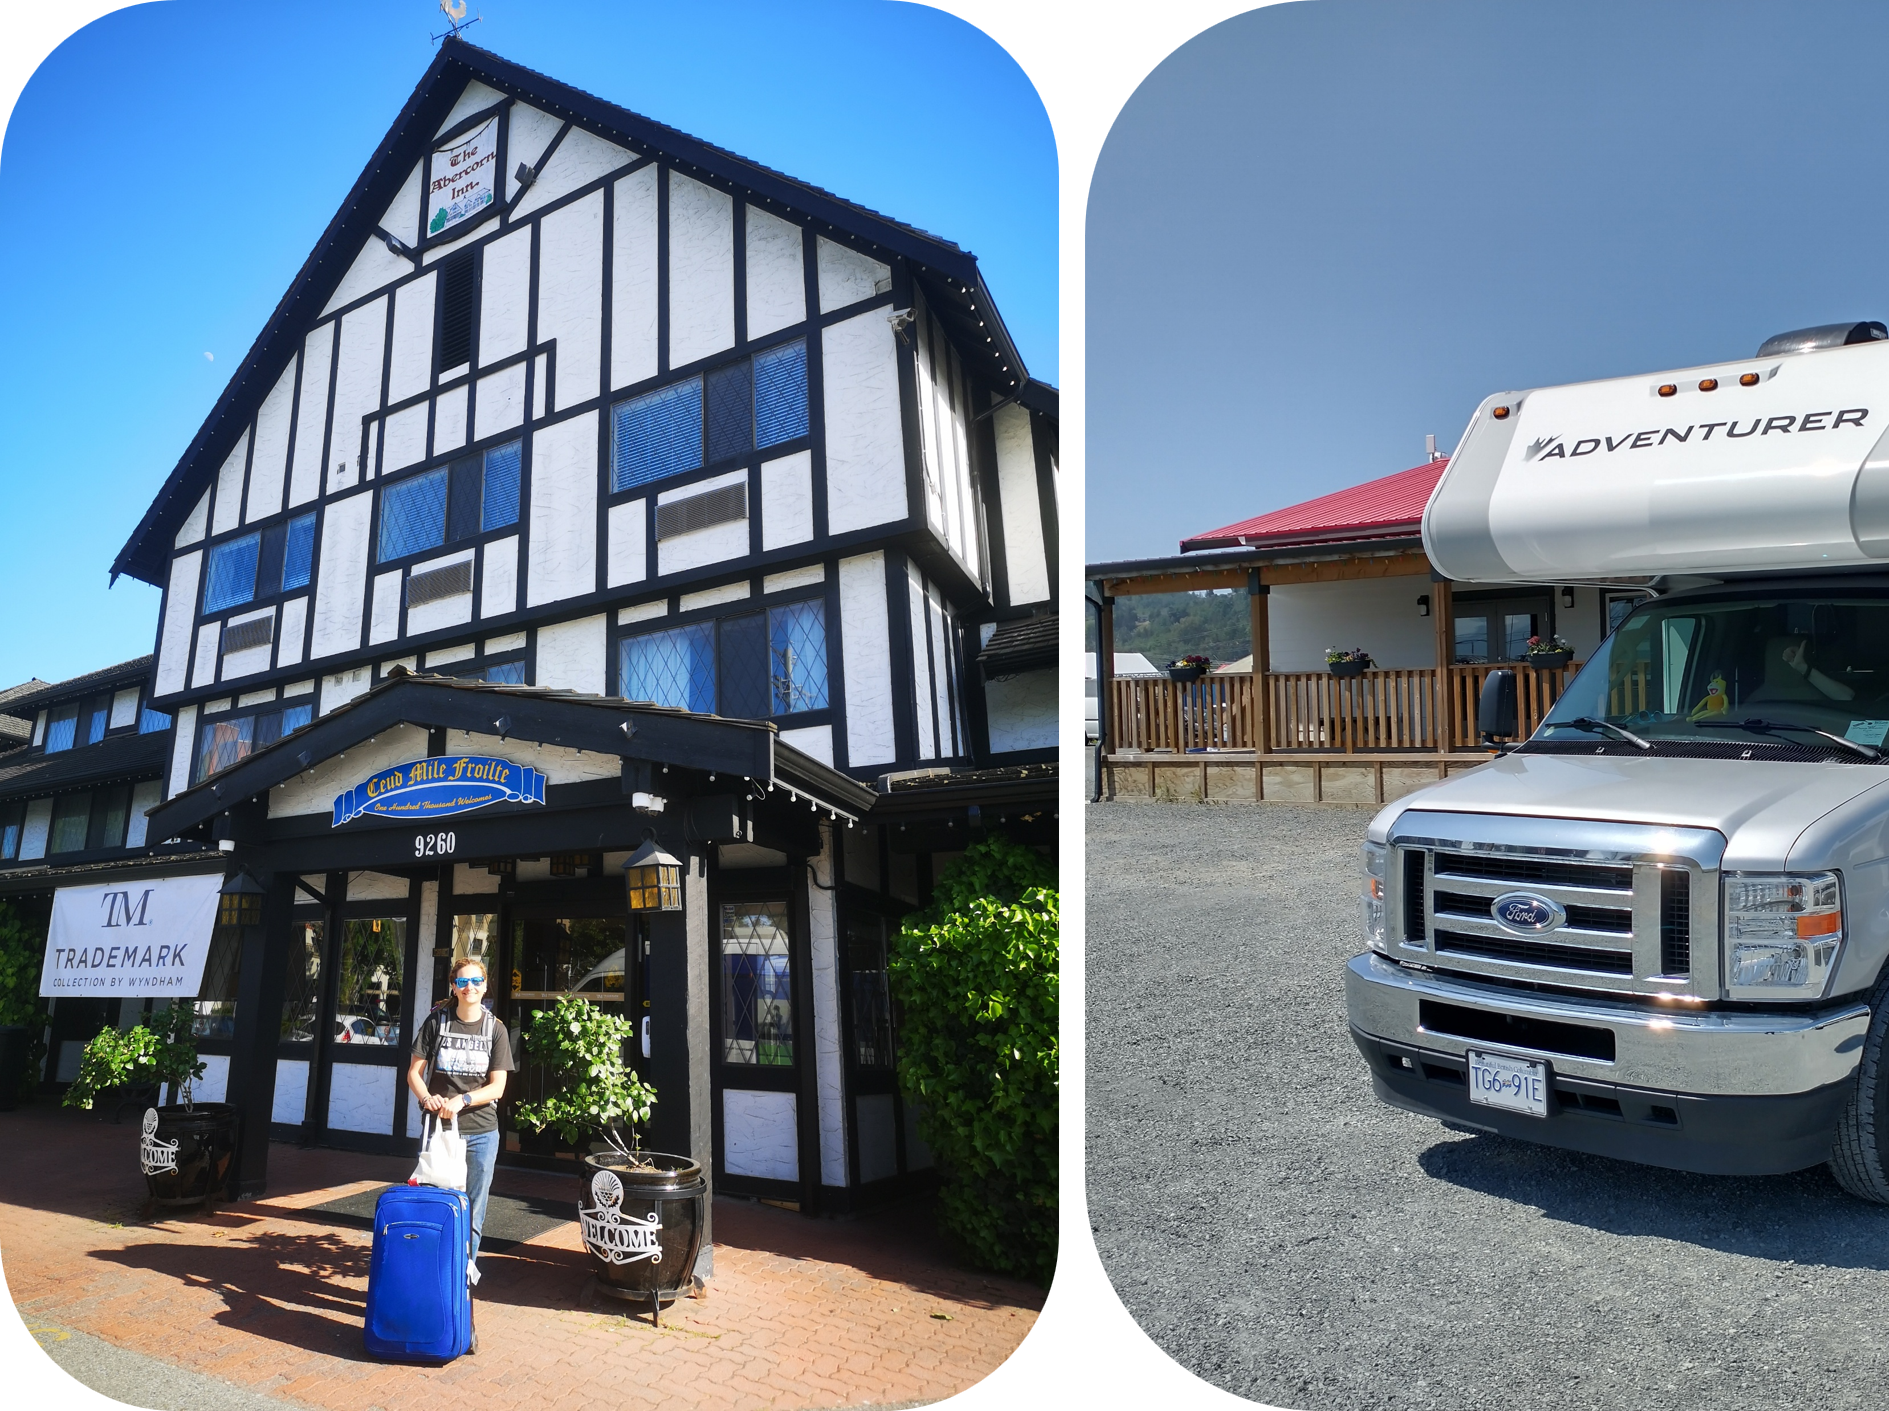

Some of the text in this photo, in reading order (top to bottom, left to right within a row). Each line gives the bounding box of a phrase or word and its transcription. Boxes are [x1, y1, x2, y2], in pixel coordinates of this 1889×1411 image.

[449, 146, 478, 167] The
[430, 150, 497, 194] Abercorn
[1538, 408, 1870, 462] ADVENTURER
[367, 770, 403, 797] Ceud
[407, 760, 447, 786] Mile
[374, 794, 492, 811] One Hundred Thousand Welcomes
[415, 832, 456, 857] 9260
[100, 889, 155, 928] TM
[1506, 903, 1538, 923] Ford
[56, 943, 188, 969] TRADEMARK
[53, 976, 184, 988] COLLECTION BY WYNDHAM
[581, 1217, 660, 1248] WELCOME
